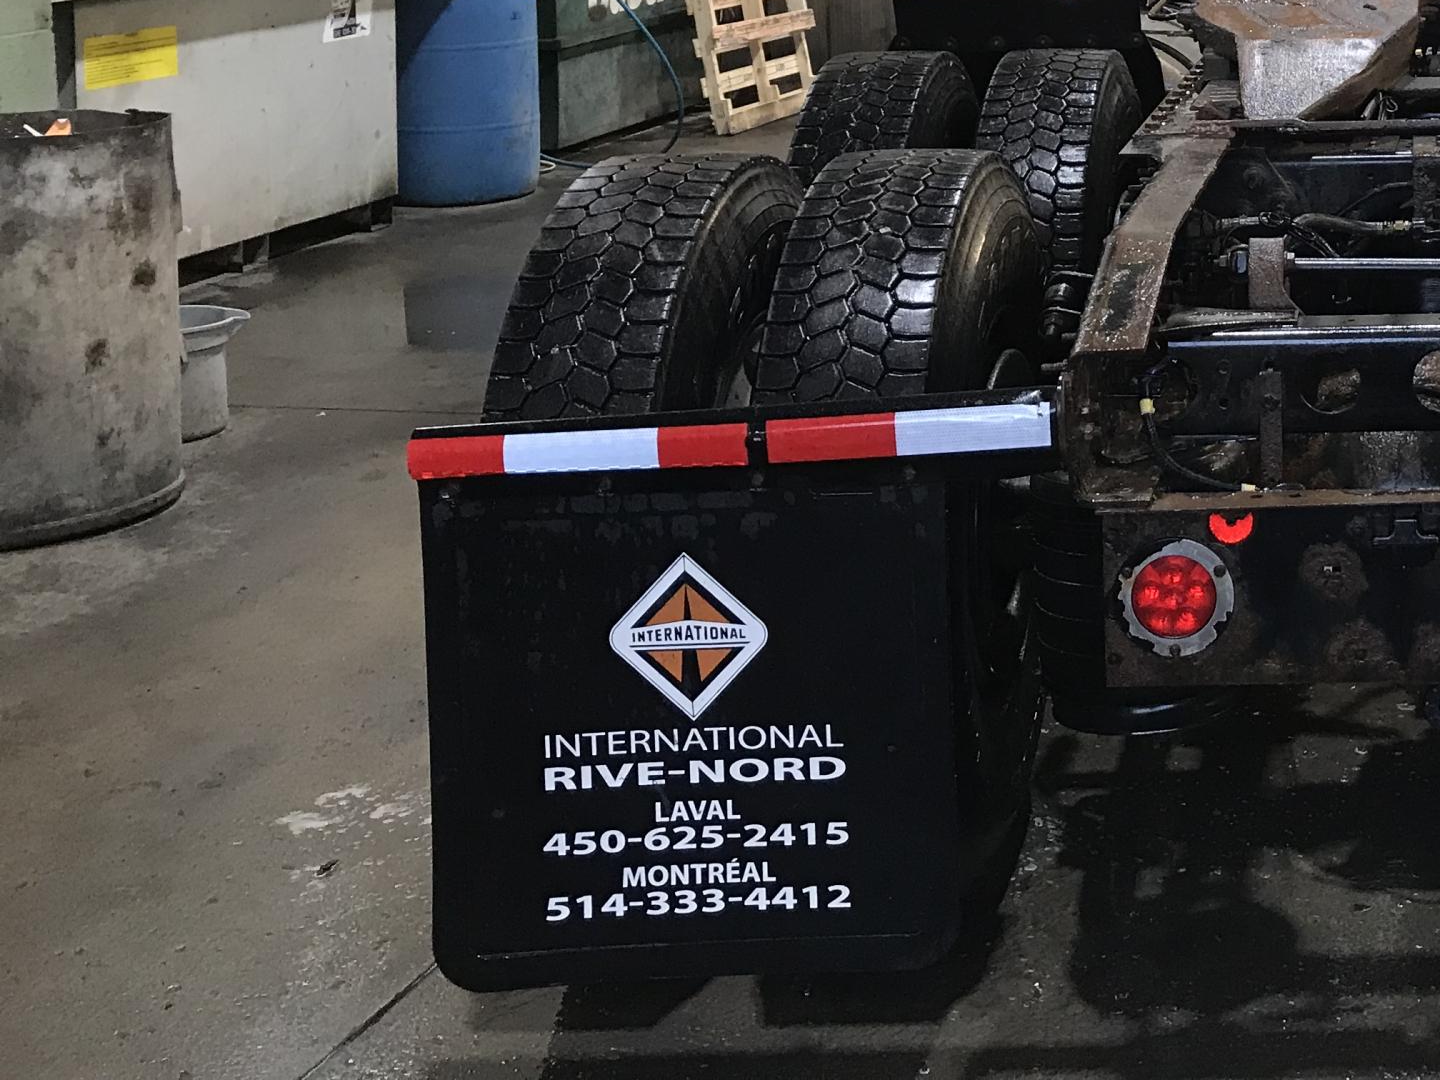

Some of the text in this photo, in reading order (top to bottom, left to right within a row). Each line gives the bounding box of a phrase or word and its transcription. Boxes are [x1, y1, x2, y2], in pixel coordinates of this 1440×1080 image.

[632, 624, 747, 643] INTERNATIONAL
[544, 723, 845, 759] INTERNATIONAL
[544, 756, 848, 791] RIVE-NORD
[654, 798, 742, 823] LAVAL
[542, 821, 849, 857] 450-625-2415
[622, 858, 777, 889] MONTRÉAL
[545, 884, 852, 922] 514-333-4412
